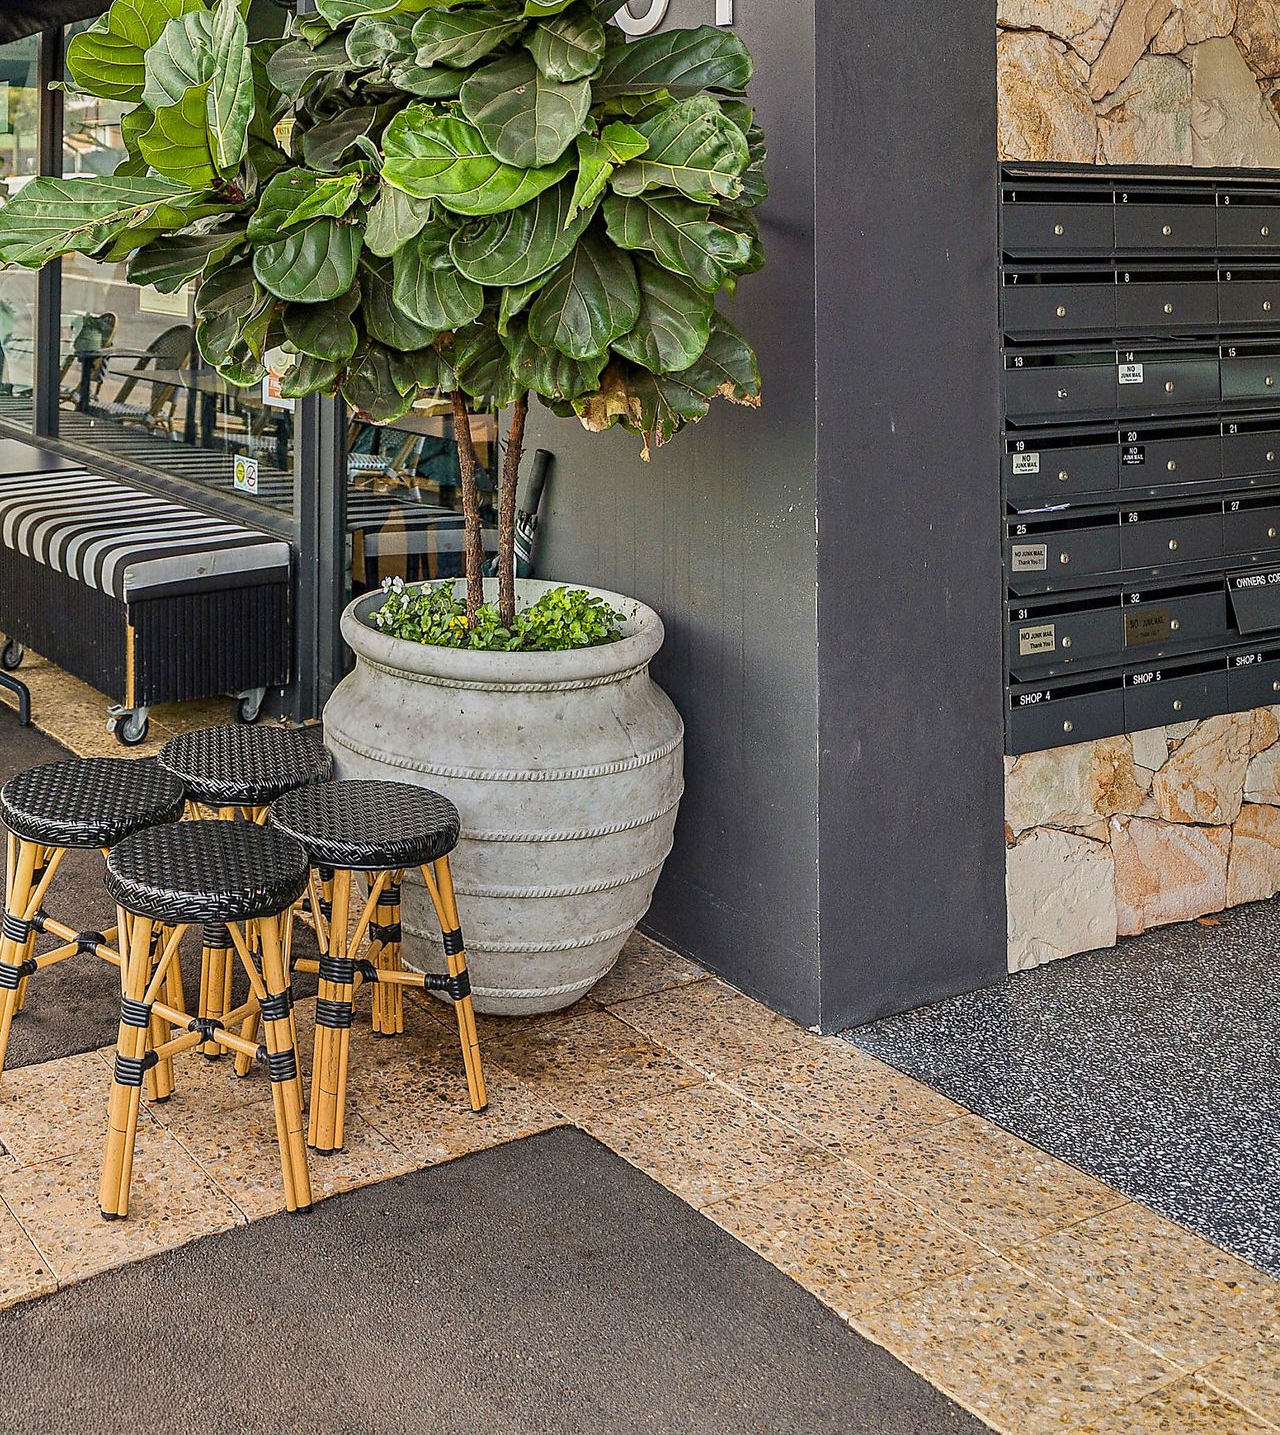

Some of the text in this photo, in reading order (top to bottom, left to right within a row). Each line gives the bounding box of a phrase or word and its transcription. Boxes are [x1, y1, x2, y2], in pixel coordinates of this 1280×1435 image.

[1011, 191, 1016, 202] 1
[1122, 193, 1128, 203] 2
[1224, 195, 1230, 205] 3
[1012, 274, 1018, 285] 7
[1124, 273, 1130, 283] 8
[1226, 271, 1231, 281] 9
[1124, 351, 1135, 362] 14
[1228, 347, 1236, 357] 15
[1013, 356, 1024, 367] 13
[1126, 365, 1136, 373] NO
[1229, 423, 1238, 434] 21
[1127, 431, 1137, 442] 20
[1015, 440, 1025, 451] 19
[1129, 447, 1138, 455] NO
[1021, 454, 1031, 462] NO
[1231, 501, 1240, 511] 27
[1128, 512, 1139, 523] 26
[1016, 524, 1027, 535] 25
[1236, 575, 1267, 588] OWNERS
[1130, 593, 1140, 603] 32
[1018, 608, 1028, 619] 31
[1130, 619, 1139, 629] NO
[1021, 632, 1030, 641] NO
[1030, 632, 1042, 640] JUNK
[1235, 653, 1262, 667] SHOP 6
[1132, 671, 1161, 685] SHOP 5
[1019, 690, 1051, 705] SHOP 4
